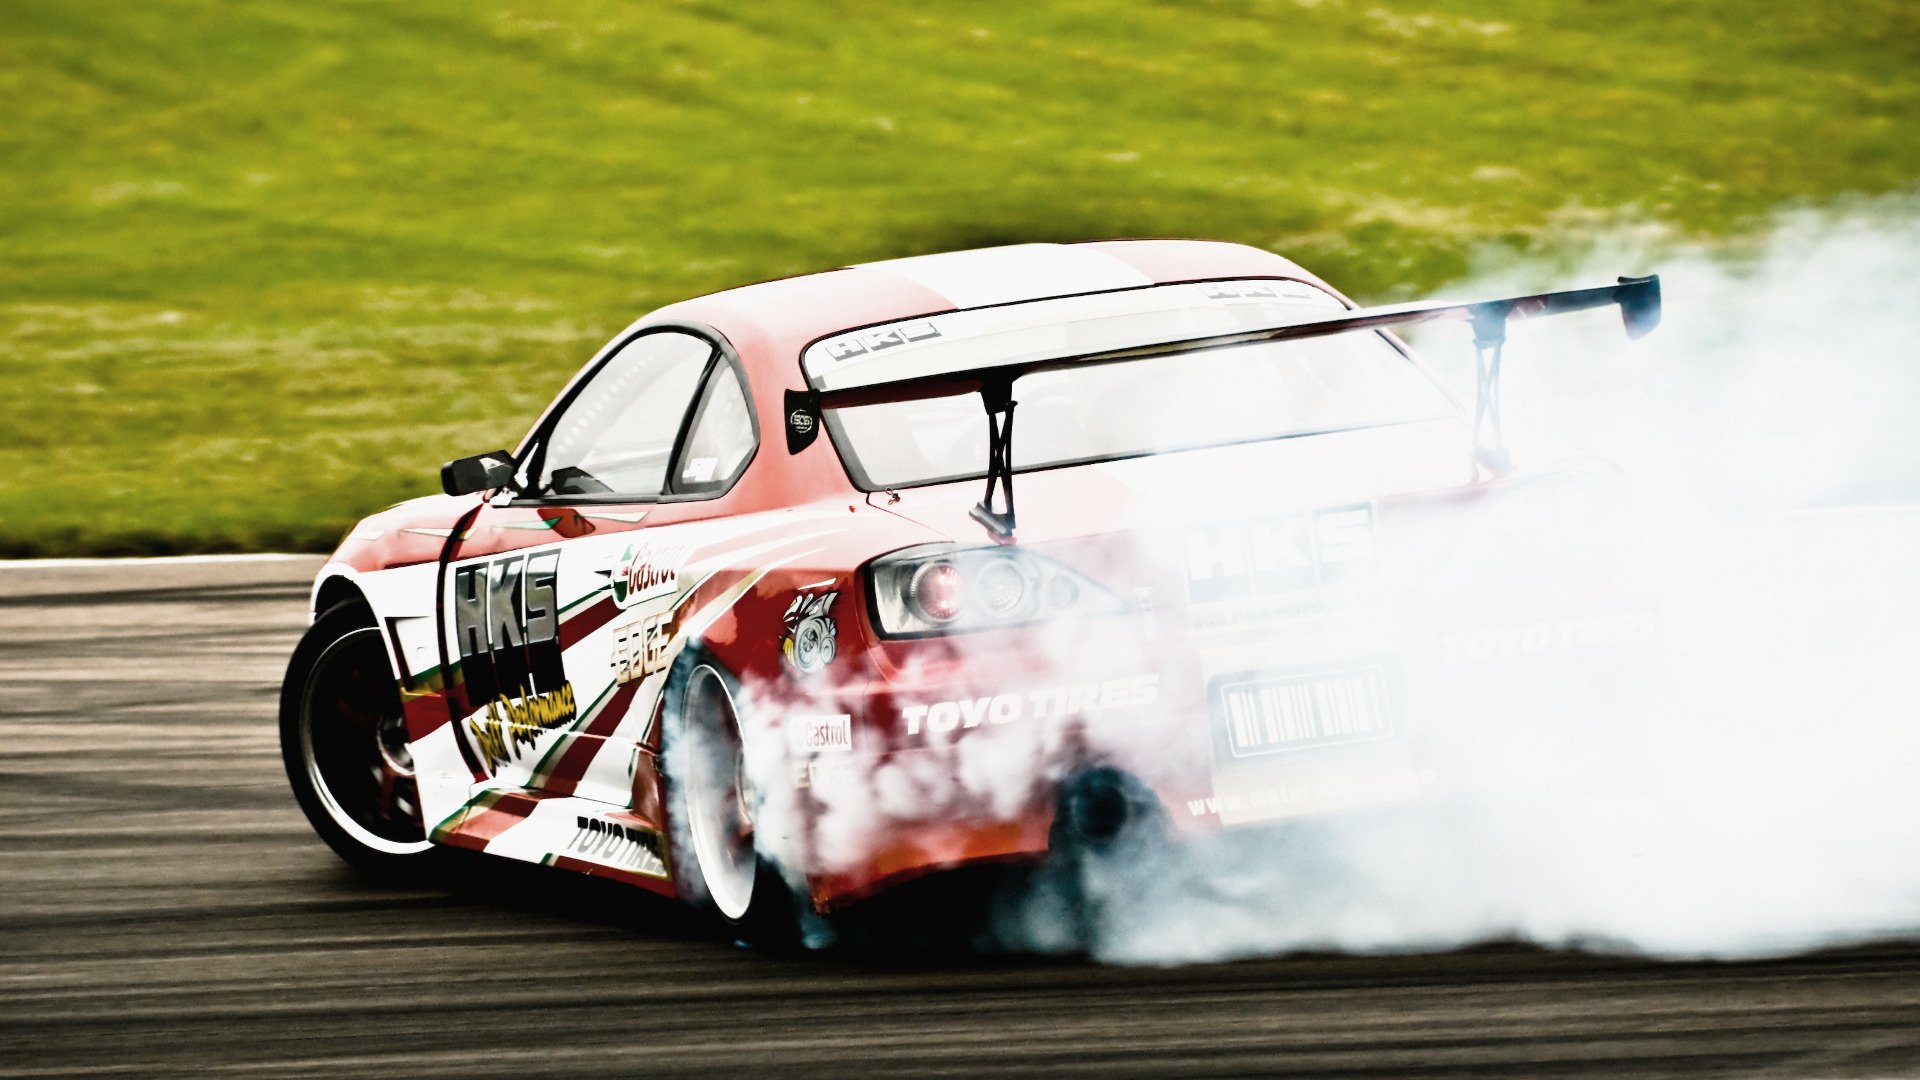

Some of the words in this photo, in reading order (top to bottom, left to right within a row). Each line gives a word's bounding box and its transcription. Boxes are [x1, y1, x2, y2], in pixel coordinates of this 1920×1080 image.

[829, 322, 942, 361] HKS
[629, 538, 698, 595] Castrol
[1187, 506, 1371, 585] HKS
[456, 550, 560, 656] HKS
[612, 610, 675, 686] EDGE
[805, 720, 849, 747] Castrol
[903, 690, 1023, 736] TOYO
[1026, 674, 1160, 718] TIRES
[567, 816, 625, 859] TOYO
